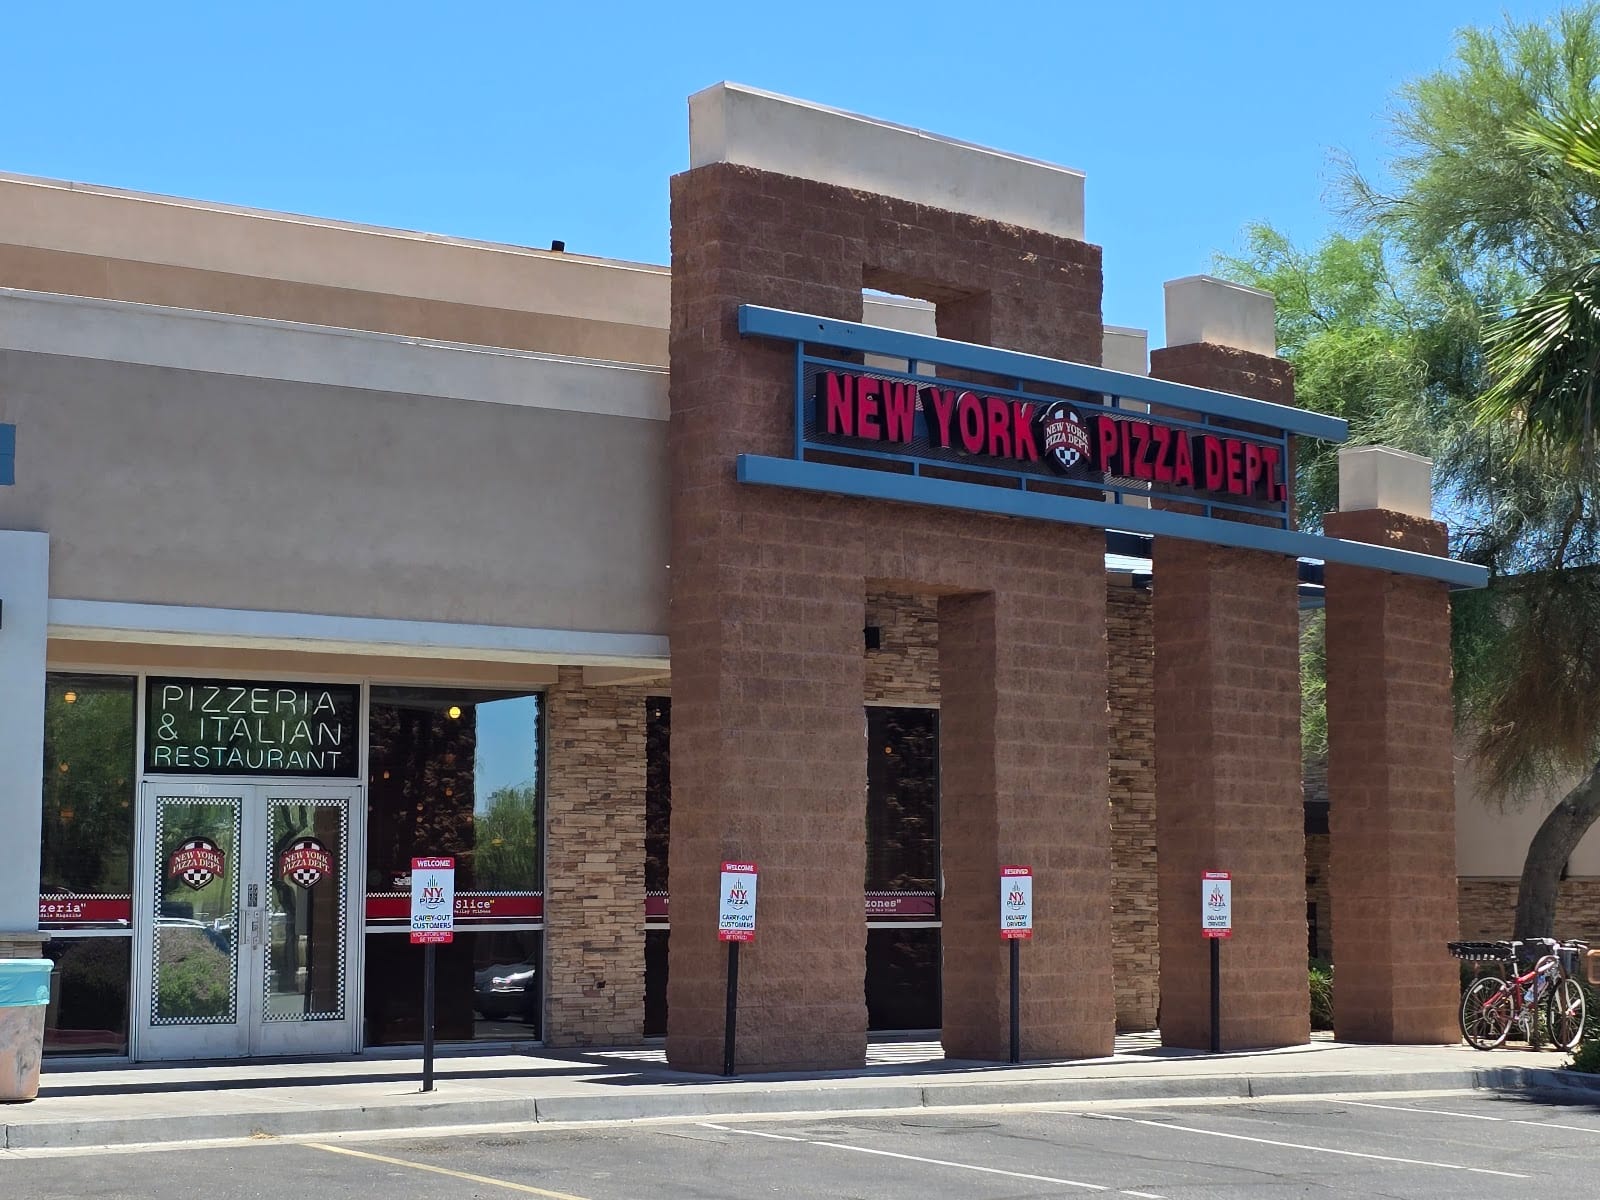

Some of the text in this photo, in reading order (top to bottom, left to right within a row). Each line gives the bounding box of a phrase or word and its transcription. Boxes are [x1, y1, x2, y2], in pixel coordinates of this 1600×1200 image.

[825, 370, 1287, 501] NEW YORK PIZZA DEPT.
[1046, 421, 1088, 445] NEW YORK
[1045, 432, 1090, 457] PIZZA DEPT.
[162, 685, 336, 715] PIZZERIA
[157, 713, 341, 746] & ITALIAN
[154, 745, 342, 770] RESTAURANT
[175, 850, 220, 864] NEW YORK
[285, 850, 328, 864] NEW YORK
[173, 858, 197, 873] PIZZA
[283, 858, 307, 873] PIZZA
[726, 863, 754, 871] WELCOME
[424, 887, 443, 898] NY
[730, 889, 748, 900] NY
[1009, 892, 1024, 901] NY
[1211, 894, 1224, 903] NY
[455, 899, 495, 909] Slice"
